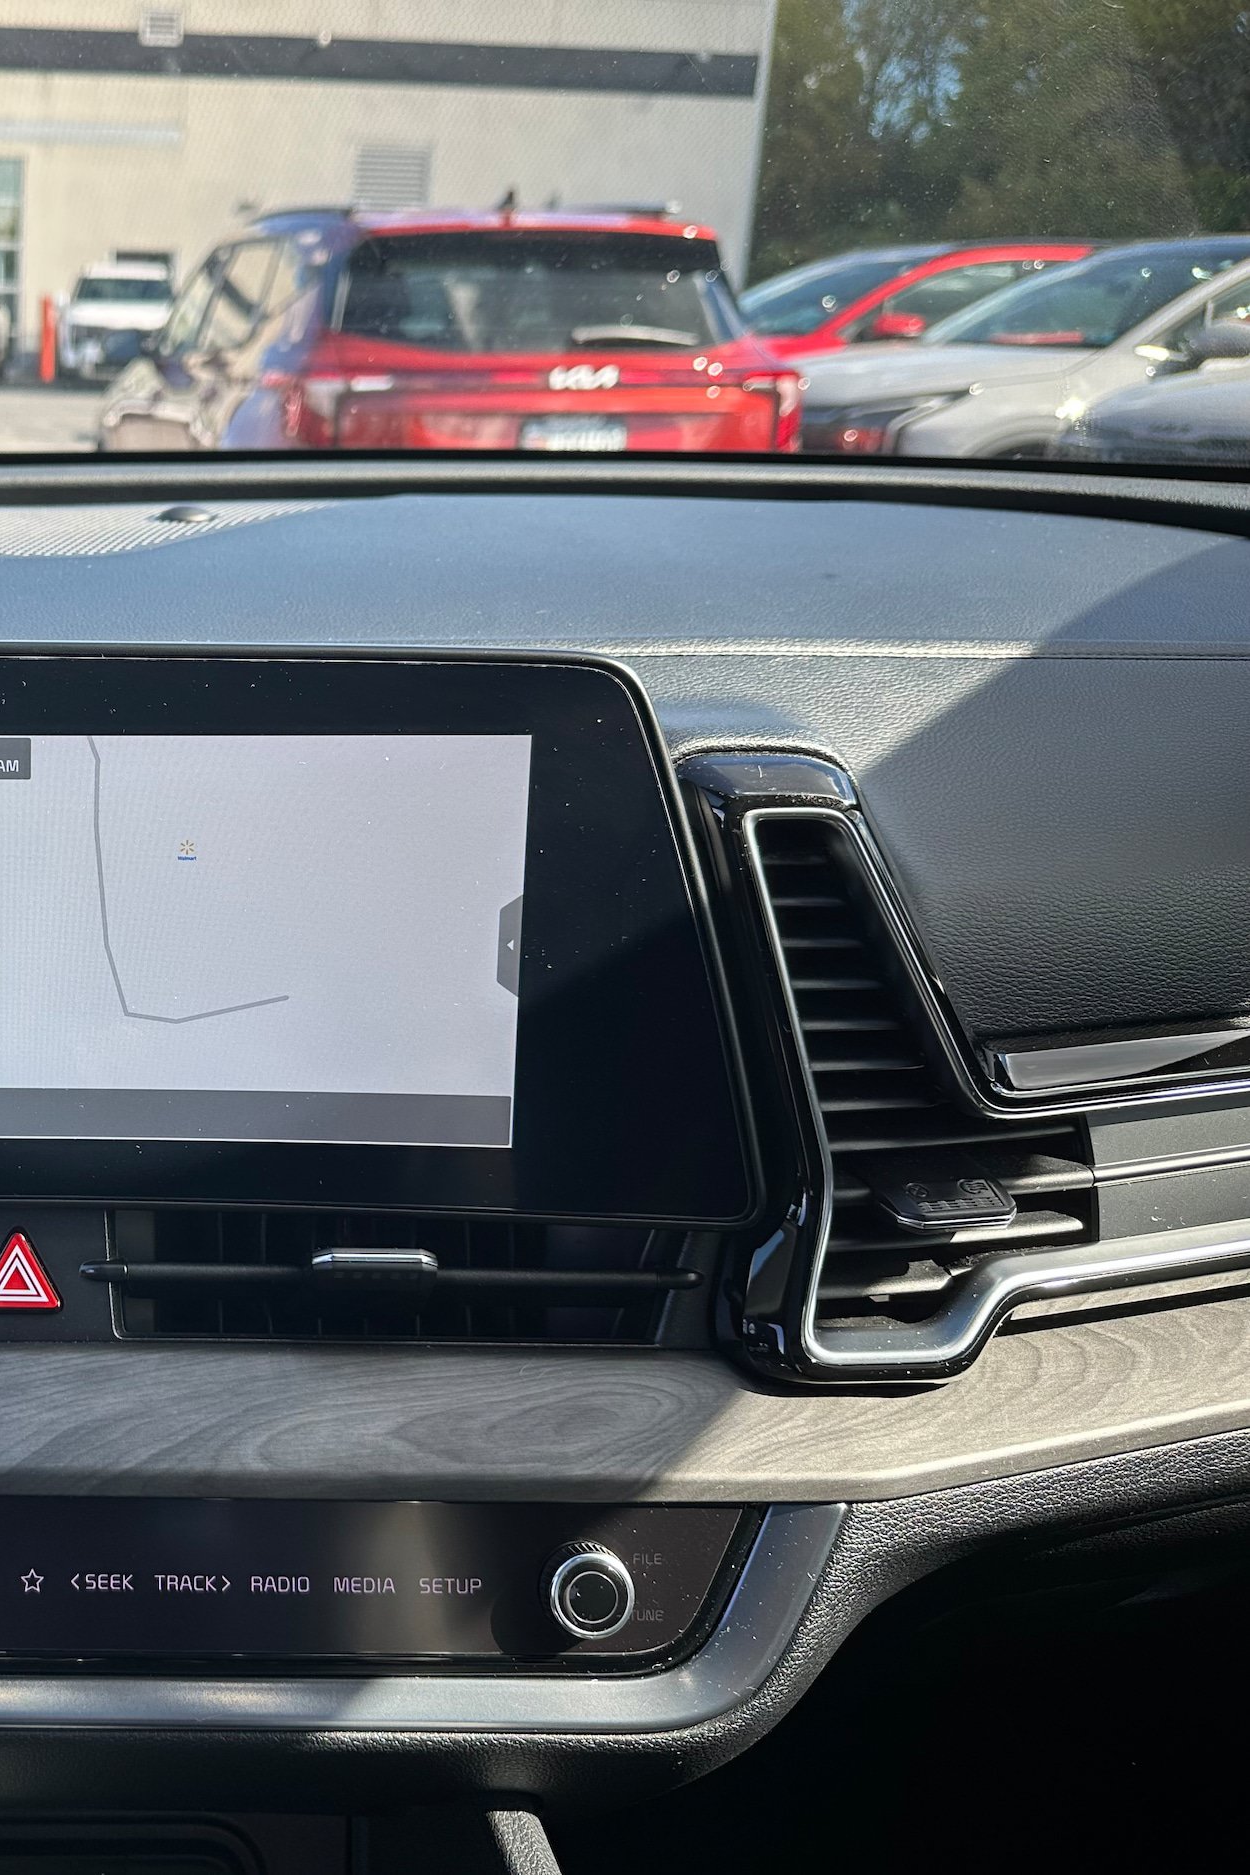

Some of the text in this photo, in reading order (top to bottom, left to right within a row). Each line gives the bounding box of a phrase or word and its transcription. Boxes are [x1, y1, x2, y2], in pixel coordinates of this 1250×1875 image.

[632, 1552, 663, 1566] FILE
[250, 1575, 311, 1593] RADIO
[333, 1576, 396, 1594] MEDIA
[419, 1577, 482, 1595] SETUP
